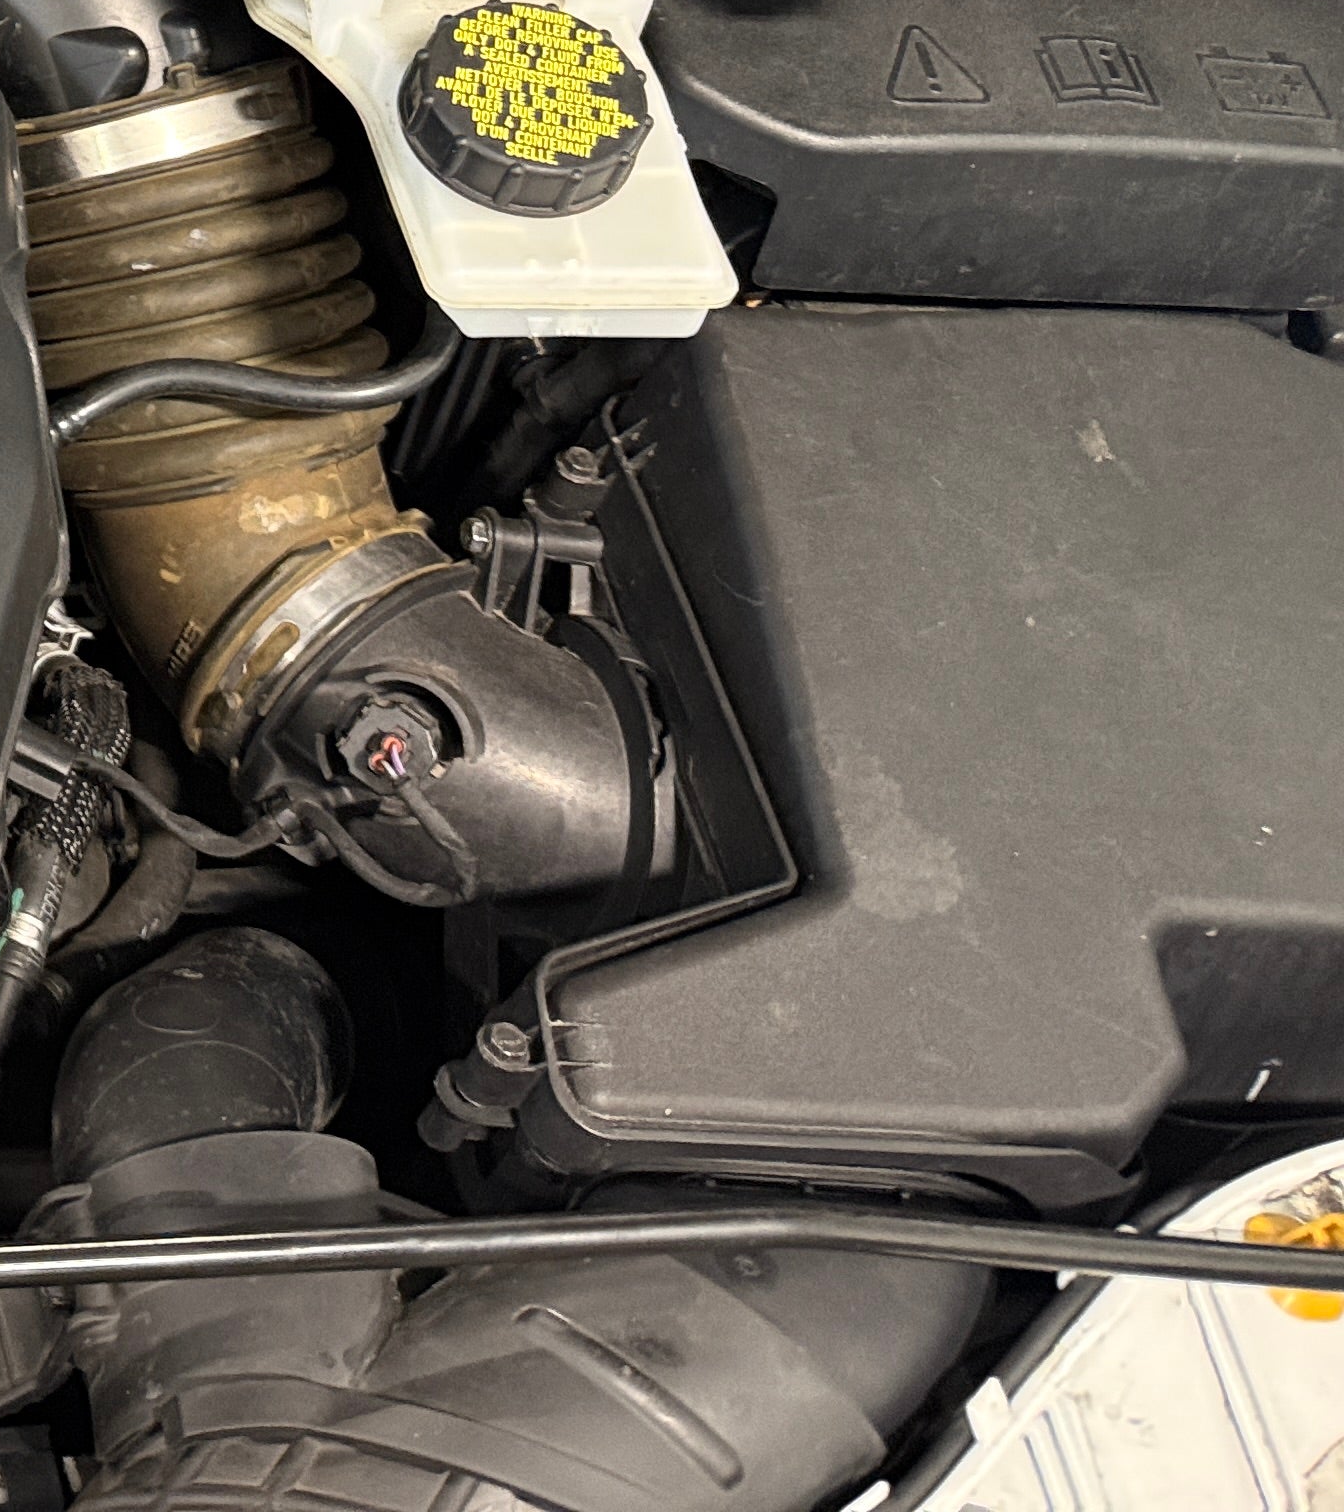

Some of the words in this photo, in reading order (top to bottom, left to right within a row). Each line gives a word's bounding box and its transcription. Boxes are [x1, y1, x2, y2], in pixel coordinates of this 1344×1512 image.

[459, 17, 509, 39] BEFORE
[515, 28, 587, 55] REMOVING.
[593, 44, 620, 62] USE
[476, 8, 521, 29] CLEAN
[525, 18, 571, 39] FILLER
[575, 28, 603, 45] CAP
[453, 28, 489, 46] ONLY
[494, 36, 521, 53] DOT
[541, 46, 581, 66] FLUID
[585, 55, 625, 76] FROM
[463, 43, 475, 56] A
[479, 46, 531, 68] SEALED
[535, 57, 612, 85] CONTAINER.
[435, 75, 480, 95] AVANT
[485, 85, 504, 101] DE
[509, 91, 527, 106] LE
[455, 66, 523, 92] NETTOYER
[528, 82, 547, 98] LE
[555, 87, 620, 113] BOUCHON
[451, 91, 503, 114] PLOYER
[508, 103, 536, 121] QUE
[541, 109, 562, 126] DU
[567, 115, 620, 139] LIQUIDE
[471, 107, 499, 125] DOT
[519, 118, 599, 147] PROVENANT
[476, 121, 510, 141] D'UN
[514, 129, 593, 159] CONTENANT
